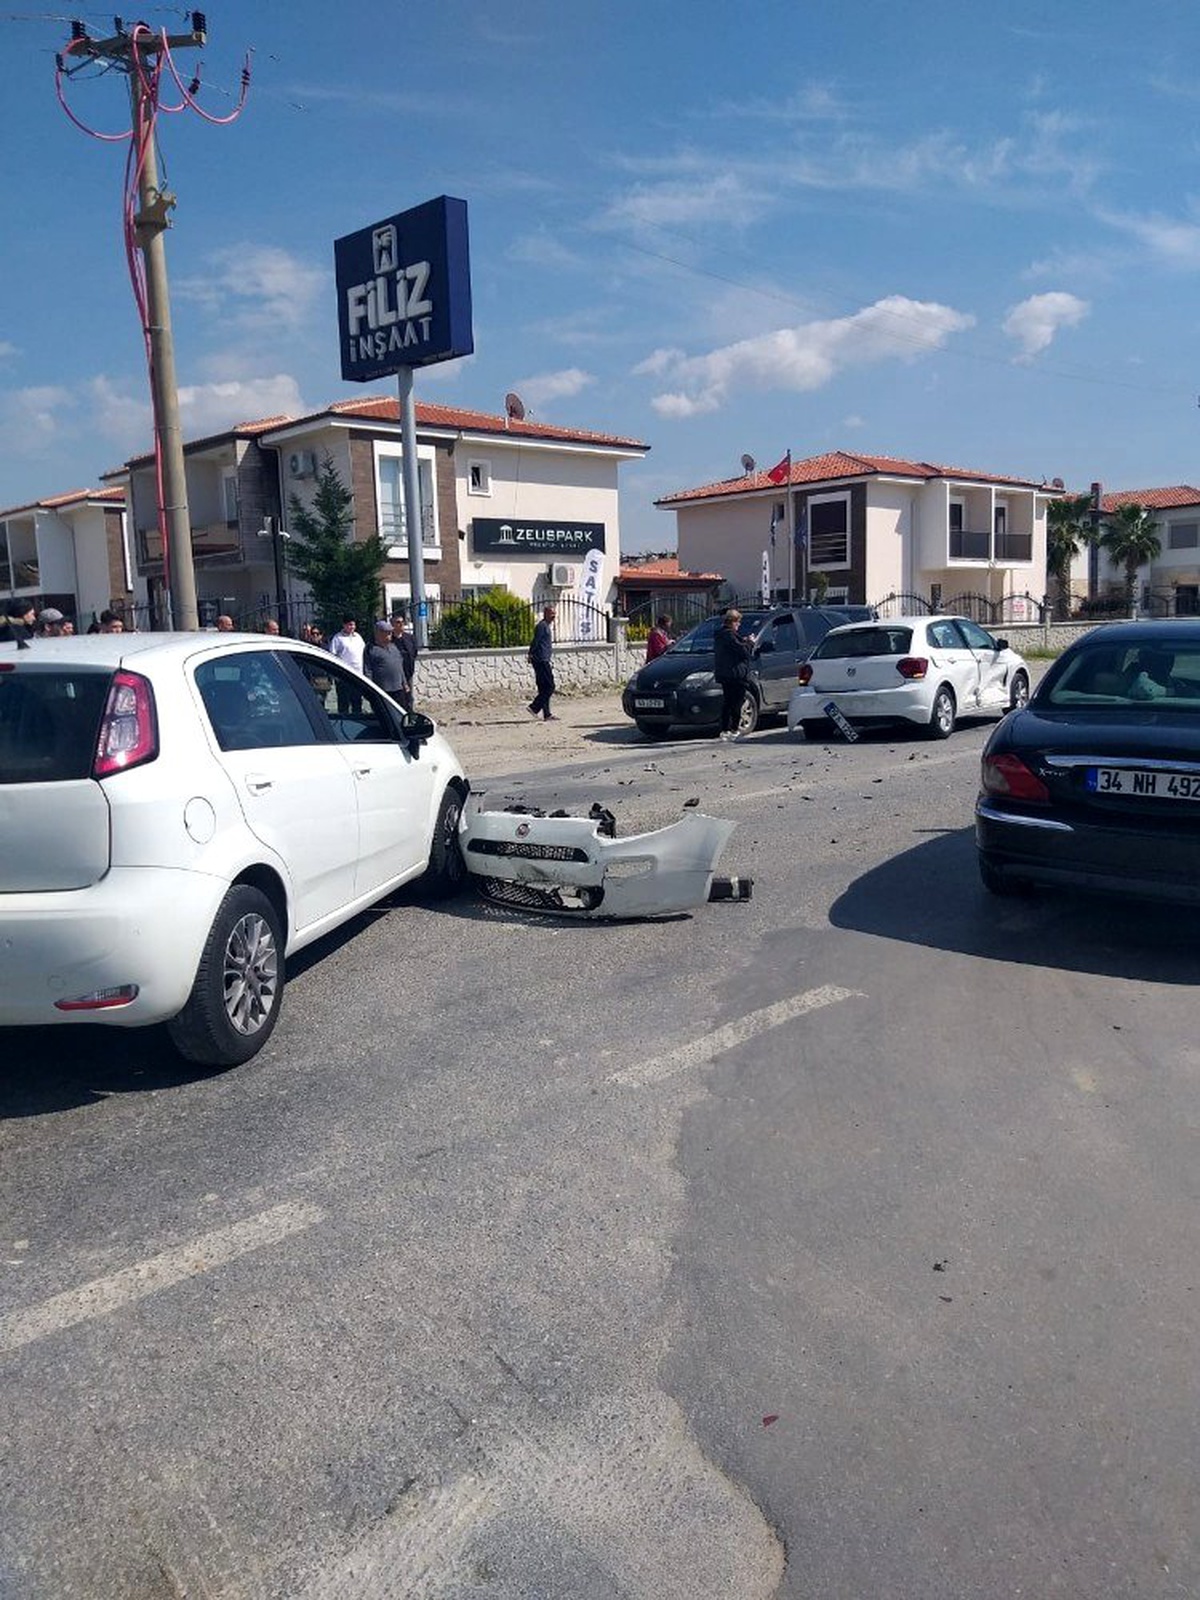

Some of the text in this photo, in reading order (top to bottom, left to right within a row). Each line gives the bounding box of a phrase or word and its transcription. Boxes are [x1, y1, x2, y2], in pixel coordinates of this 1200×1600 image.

[350, 317, 432, 362] İNŞAAT
[516, 528, 593, 542] ZEUSPARK
[1101, 771, 1122, 791] 34
[1133, 773, 1156, 794] NH
